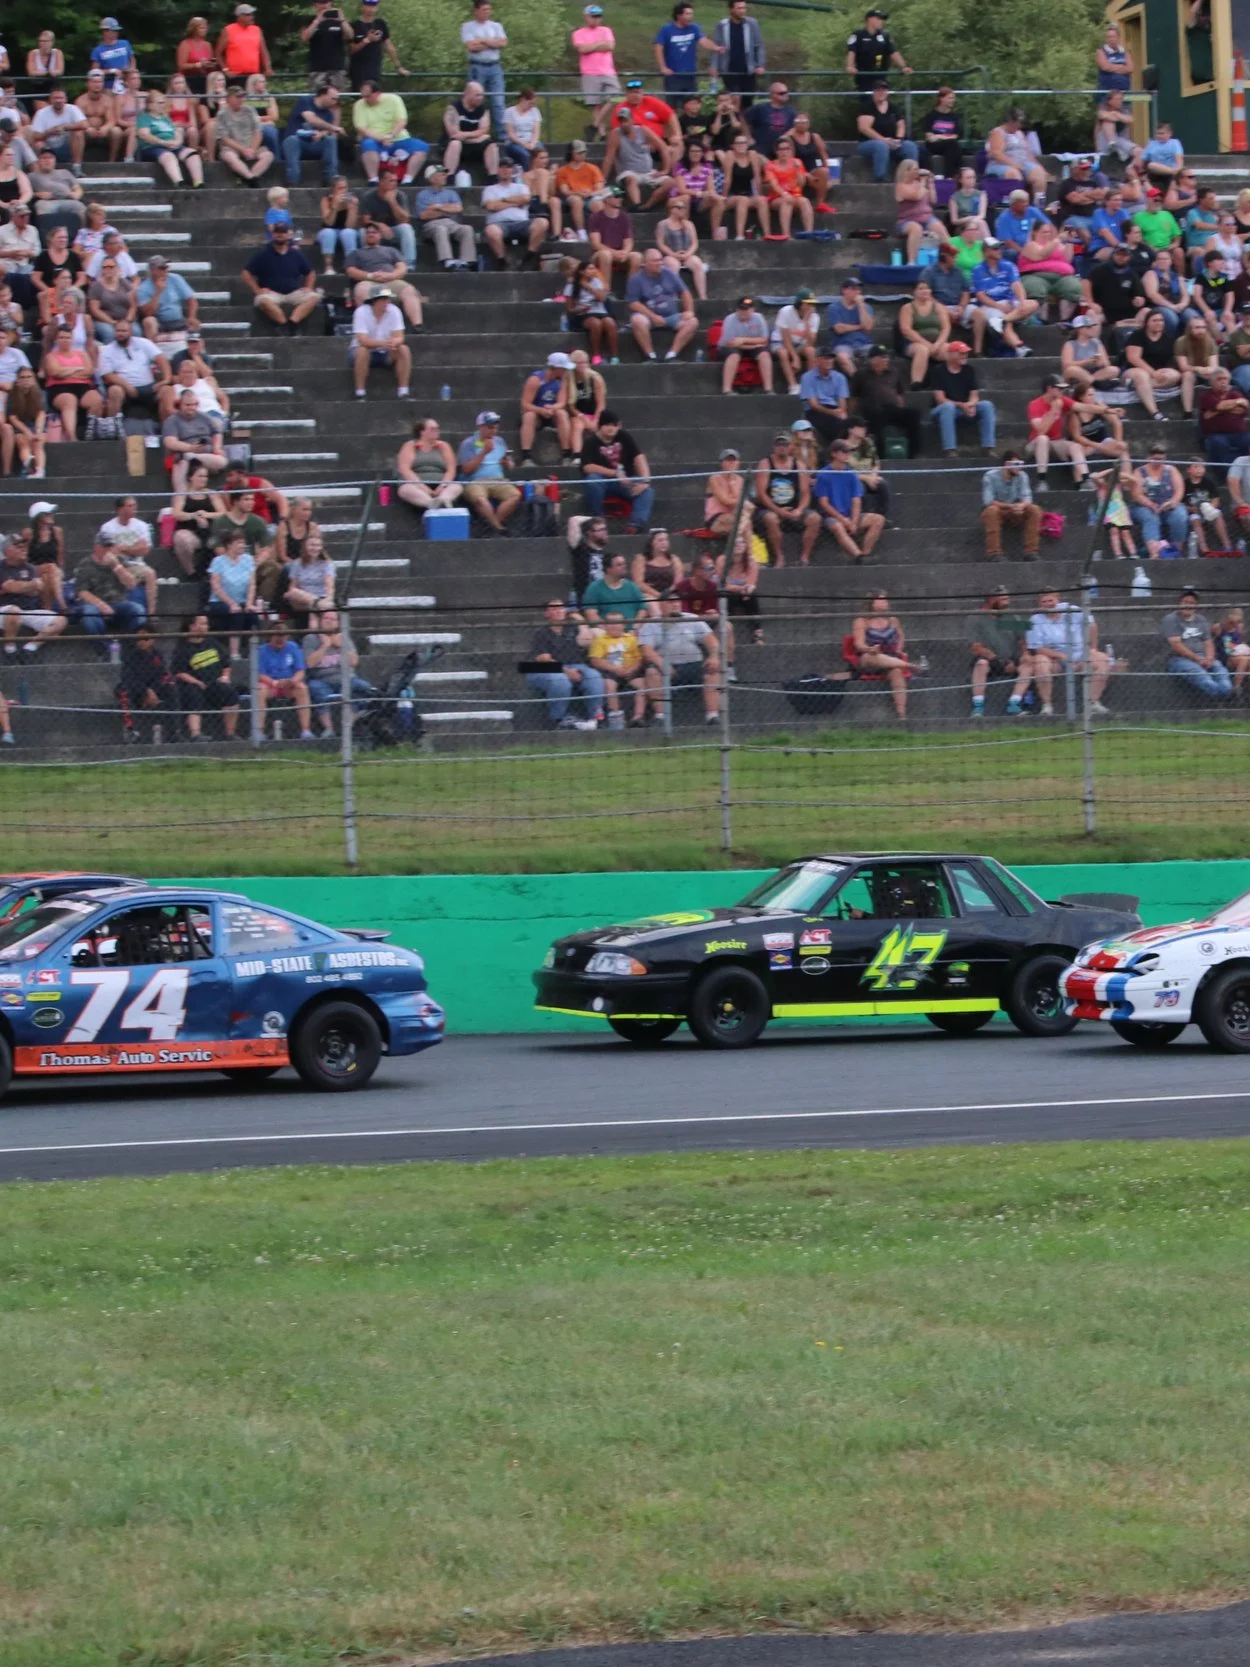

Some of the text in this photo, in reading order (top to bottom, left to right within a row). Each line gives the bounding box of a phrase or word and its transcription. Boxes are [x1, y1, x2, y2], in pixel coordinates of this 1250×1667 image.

[704, 938, 748, 954] Hoosier
[858, 920, 949, 991] 47
[235, 955, 312, 977] MID-STATE
[62, 968, 190, 1043] 74
[1154, 990, 1181, 1008] 79
[117, 1050, 156, 1065] Auto
